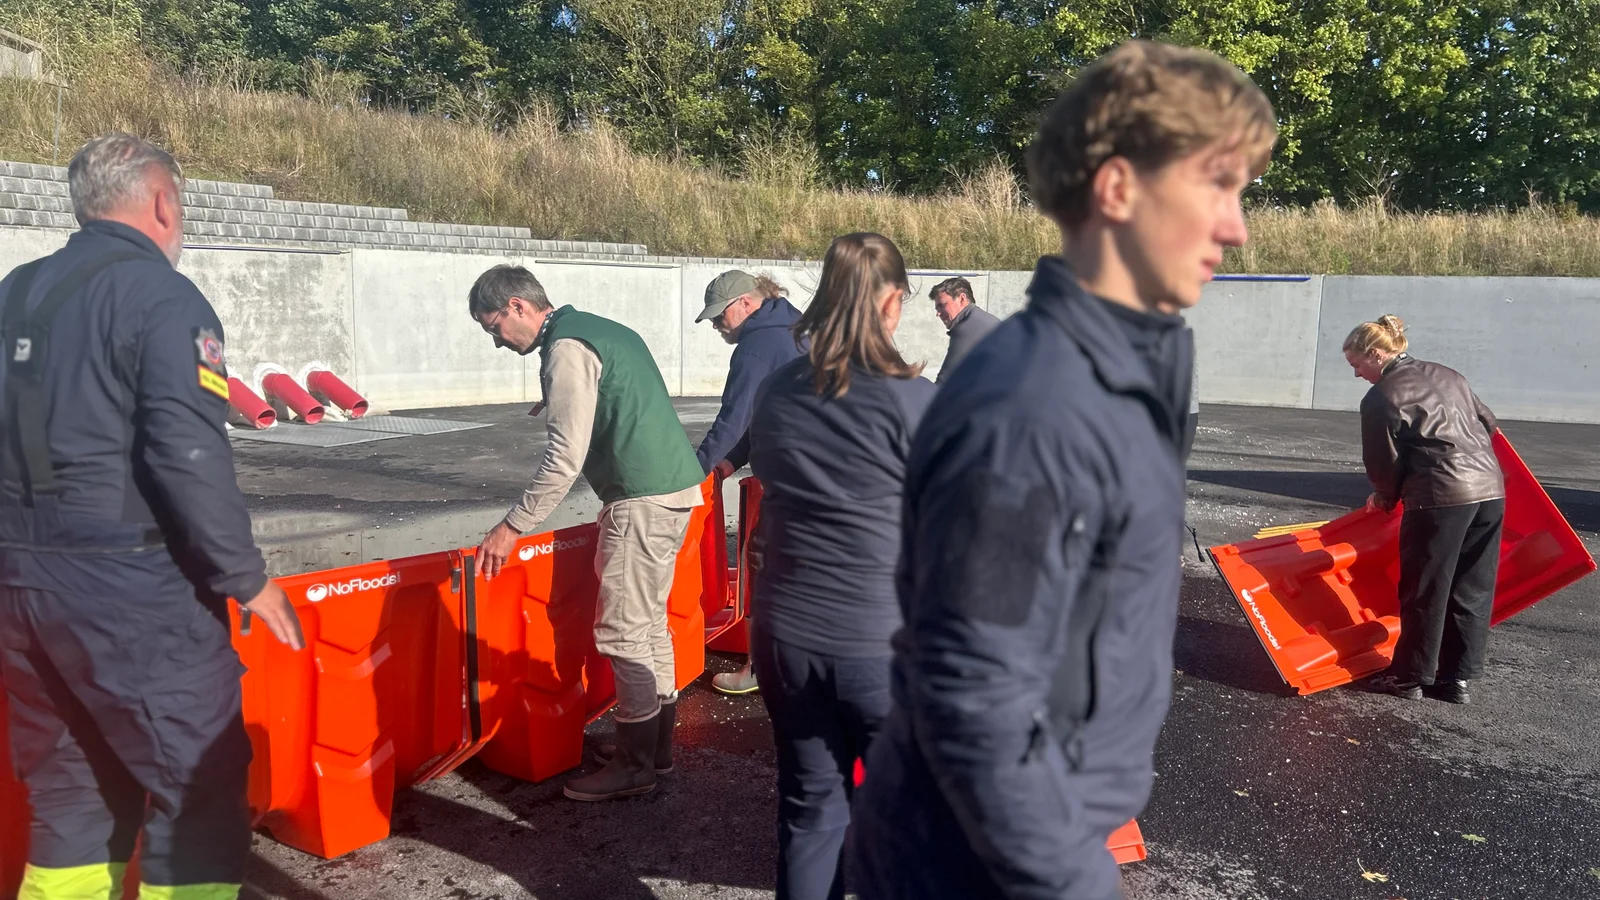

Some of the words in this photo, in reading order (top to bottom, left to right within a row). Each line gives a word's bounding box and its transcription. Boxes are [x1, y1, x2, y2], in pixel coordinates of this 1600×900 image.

[535, 534, 587, 557] NoFloods
[328, 573, 397, 597] NoFloods
[1249, 602, 1279, 648] NoFloods
